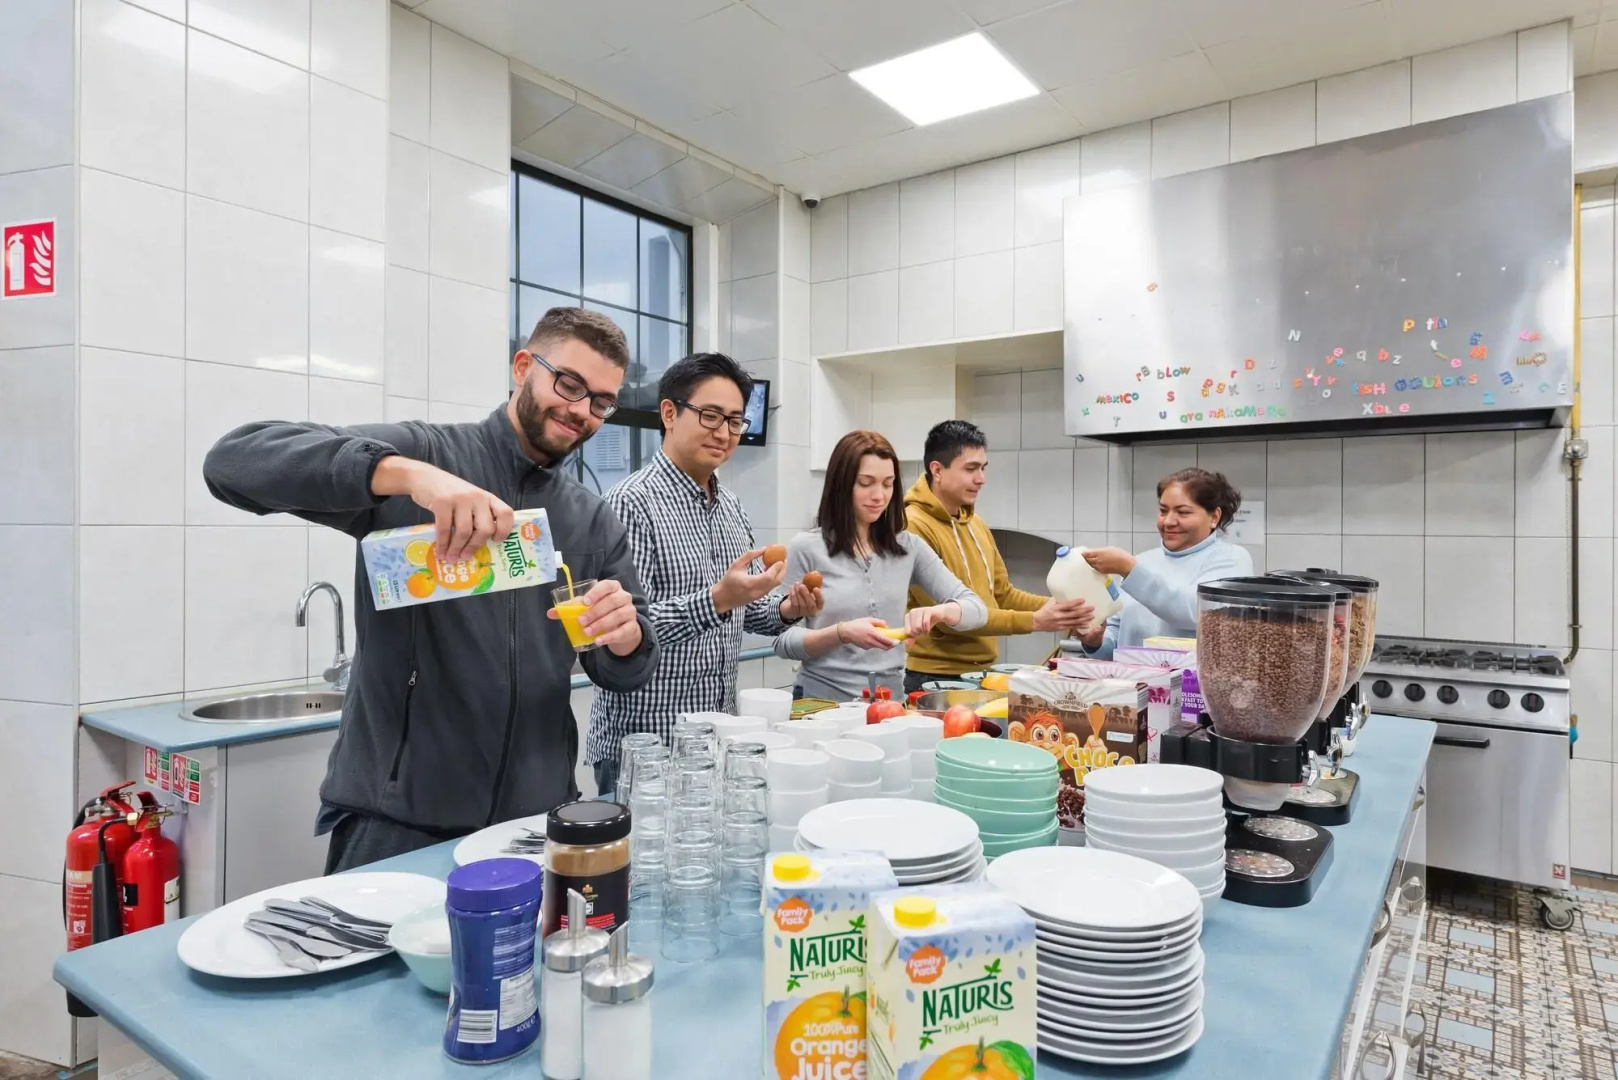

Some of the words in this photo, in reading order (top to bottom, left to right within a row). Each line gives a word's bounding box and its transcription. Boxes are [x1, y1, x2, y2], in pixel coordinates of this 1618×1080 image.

[777, 906, 809, 918] Family
[909, 955, 941, 969] Family
[810, 969, 836, 981] Truly
[837, 964, 864, 977] Juicy
[923, 975, 1014, 1028] NATURIS
[943, 1020, 970, 1034] Truly
[971, 1014, 999, 1027] Juicy
[790, 1037, 868, 1058] Orange
[791, 1056, 867, 1080] Juice
